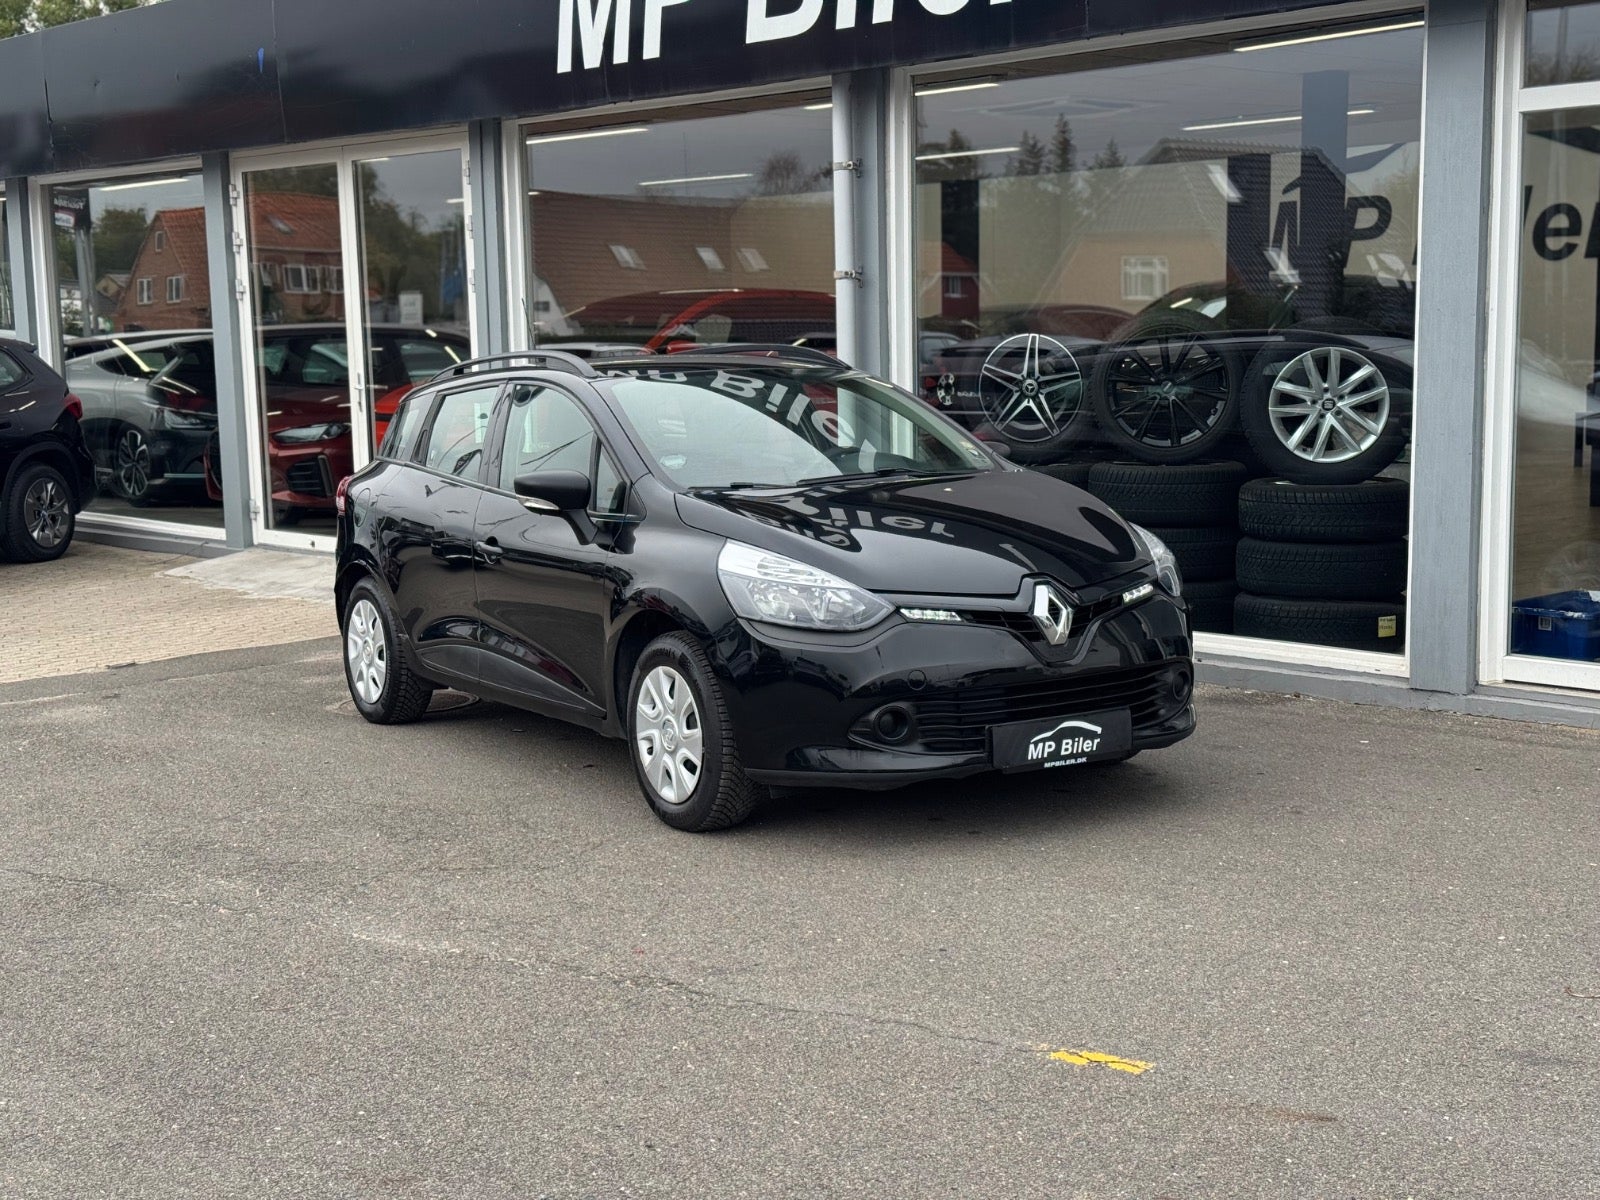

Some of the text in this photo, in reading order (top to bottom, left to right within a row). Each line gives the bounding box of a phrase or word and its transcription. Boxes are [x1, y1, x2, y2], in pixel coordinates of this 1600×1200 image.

[1027, 736, 1101, 760] MP Biler
[1043, 757, 1088, 768] MPBILER.DK
